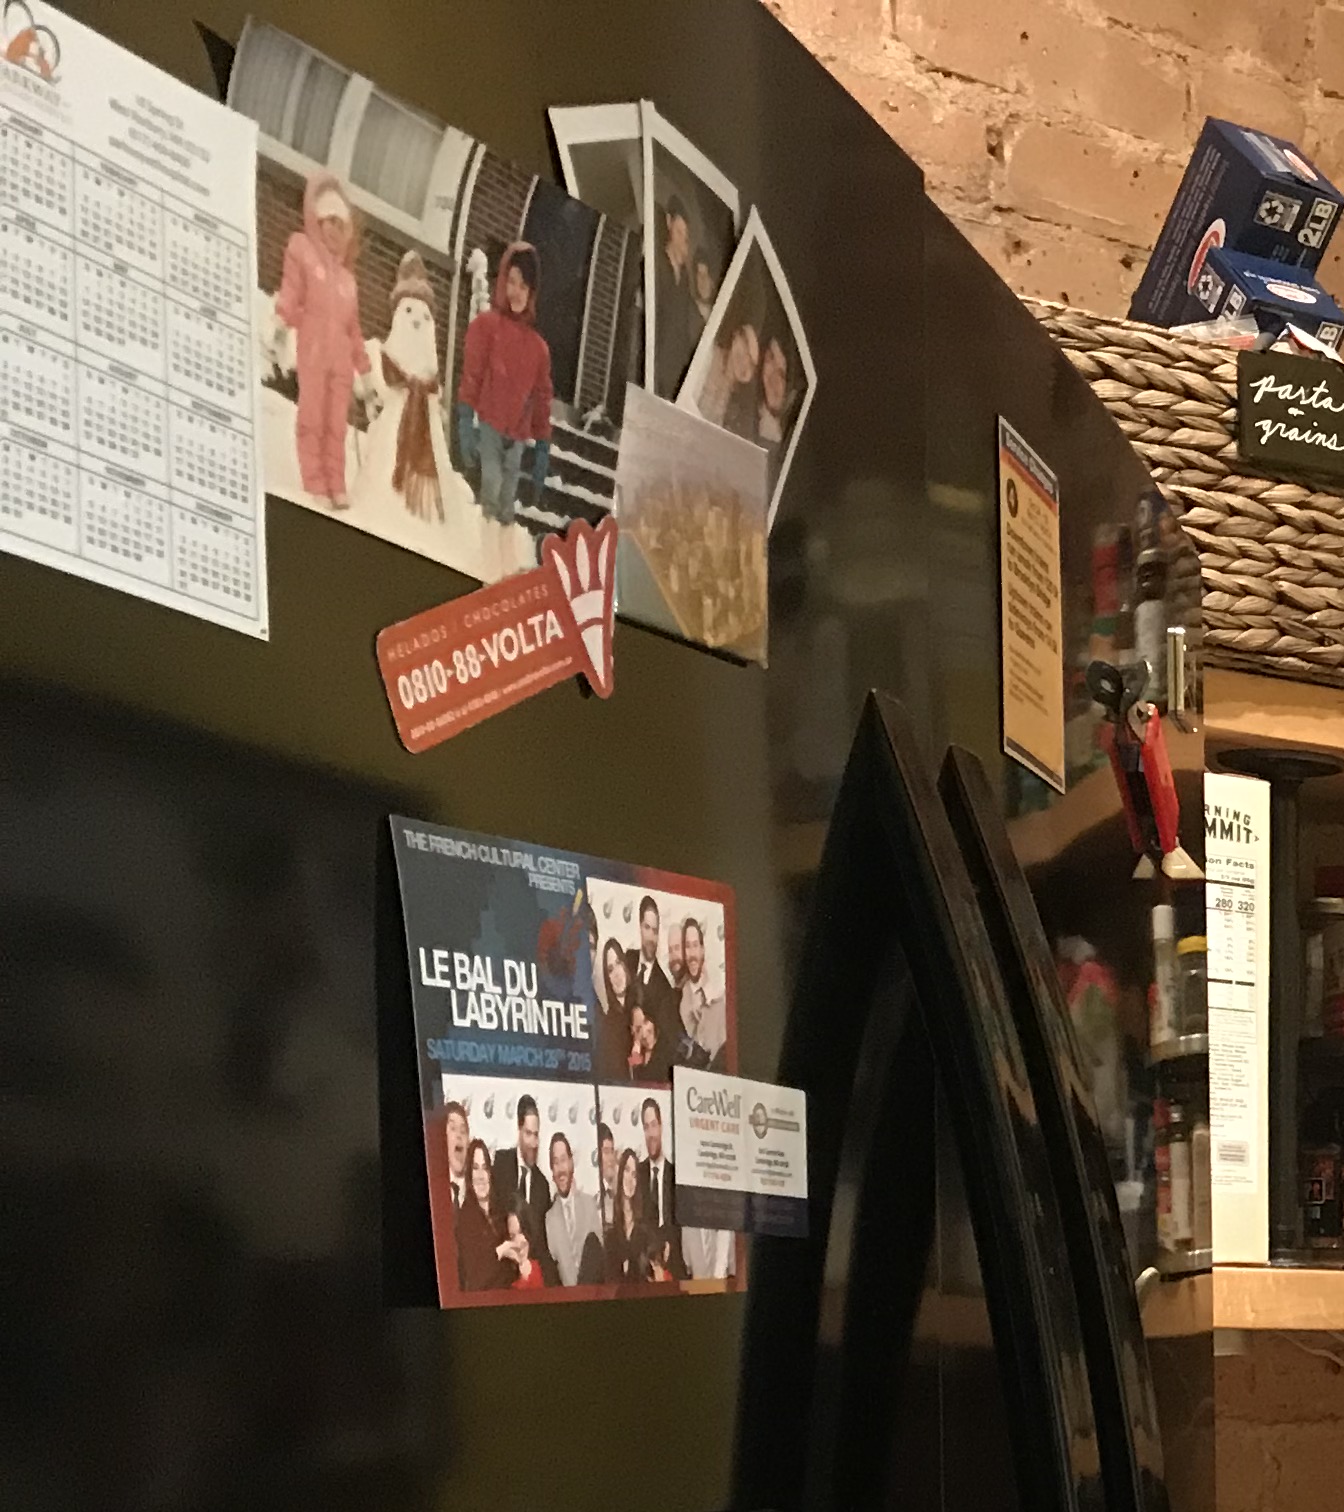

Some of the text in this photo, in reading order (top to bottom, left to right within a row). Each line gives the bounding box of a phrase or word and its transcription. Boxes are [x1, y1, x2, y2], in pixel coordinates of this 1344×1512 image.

[1298, 202, 1333, 248] 2LB
[463, 584, 550, 629] CHOCOLATES
[398, 609, 565, 710] 0810-88-VOLTA
[403, 829, 581, 880] THE FRENCH CULTURAL CENTER
[528, 872, 576, 896] PRESENTS
[1215, 897, 1255, 912] 280 320
[419, 947, 538, 999] LE BAL DU
[450, 989, 590, 1040] LABYRINTHE
[426, 1037, 497, 1064] SATURDAY
[497, 1044, 544, 1067] MARCH
[687, 1086, 742, 1119] CareWell
